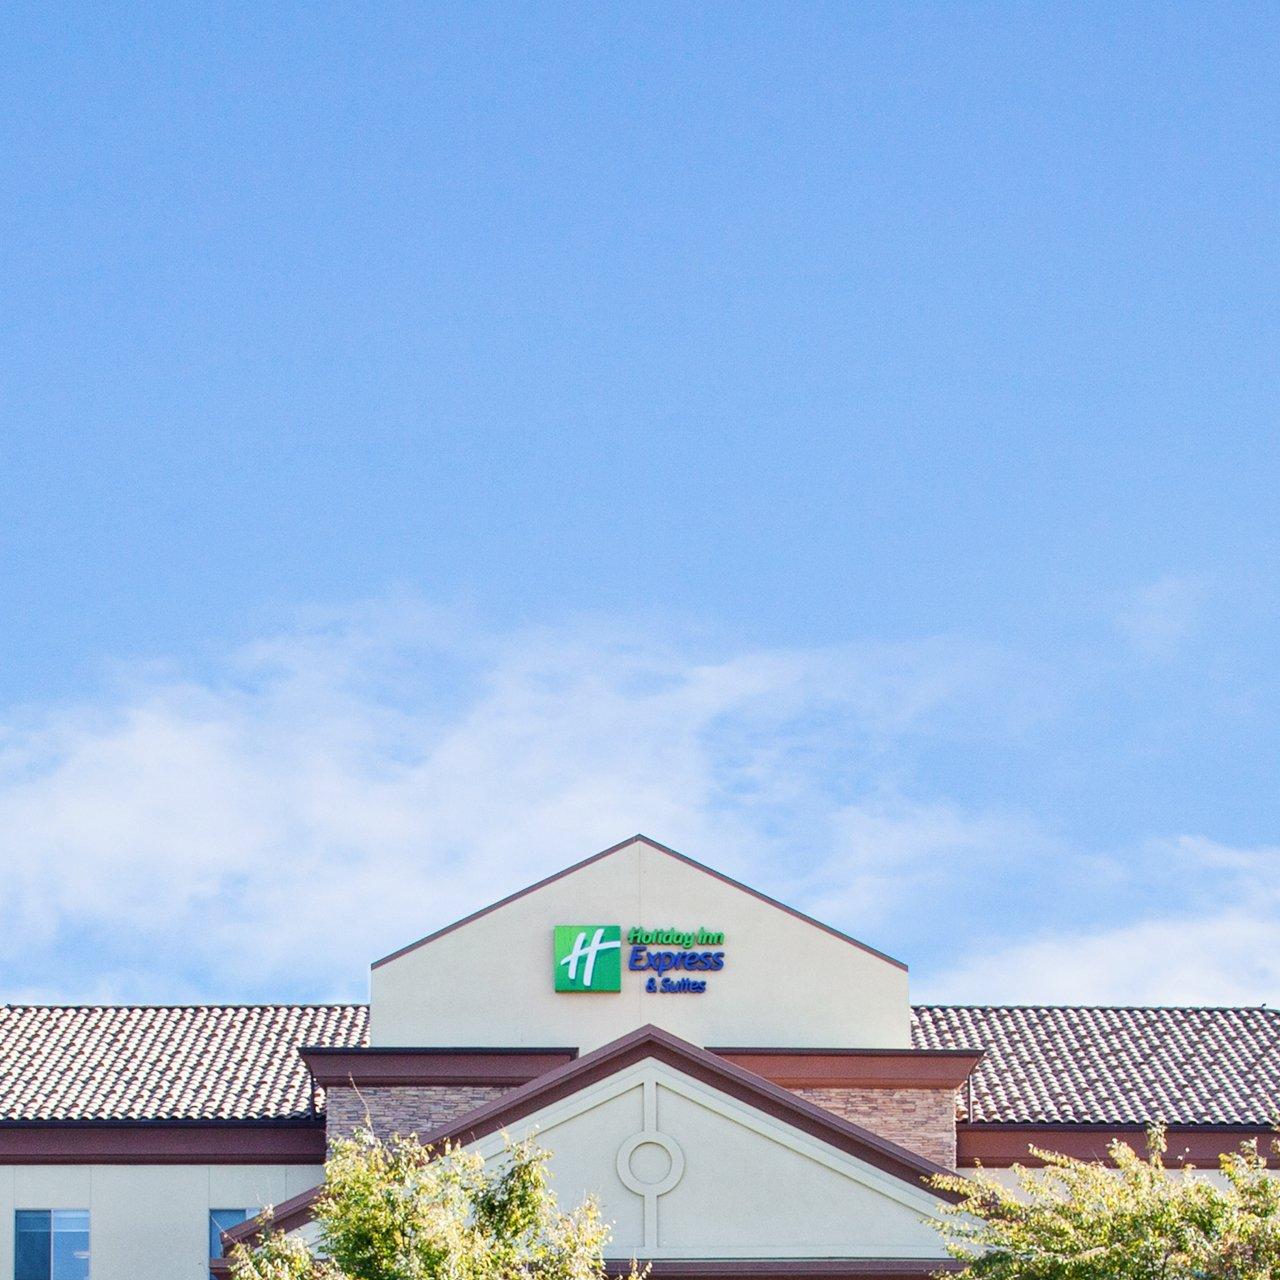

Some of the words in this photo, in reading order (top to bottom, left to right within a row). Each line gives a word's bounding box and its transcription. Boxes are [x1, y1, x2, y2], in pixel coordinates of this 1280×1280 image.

[628, 926, 694, 949] Holiday
[697, 927, 725, 945] Inn
[628, 946, 725, 977] Express
[646, 977, 657, 993] &
[660, 977, 706, 993] Suites
